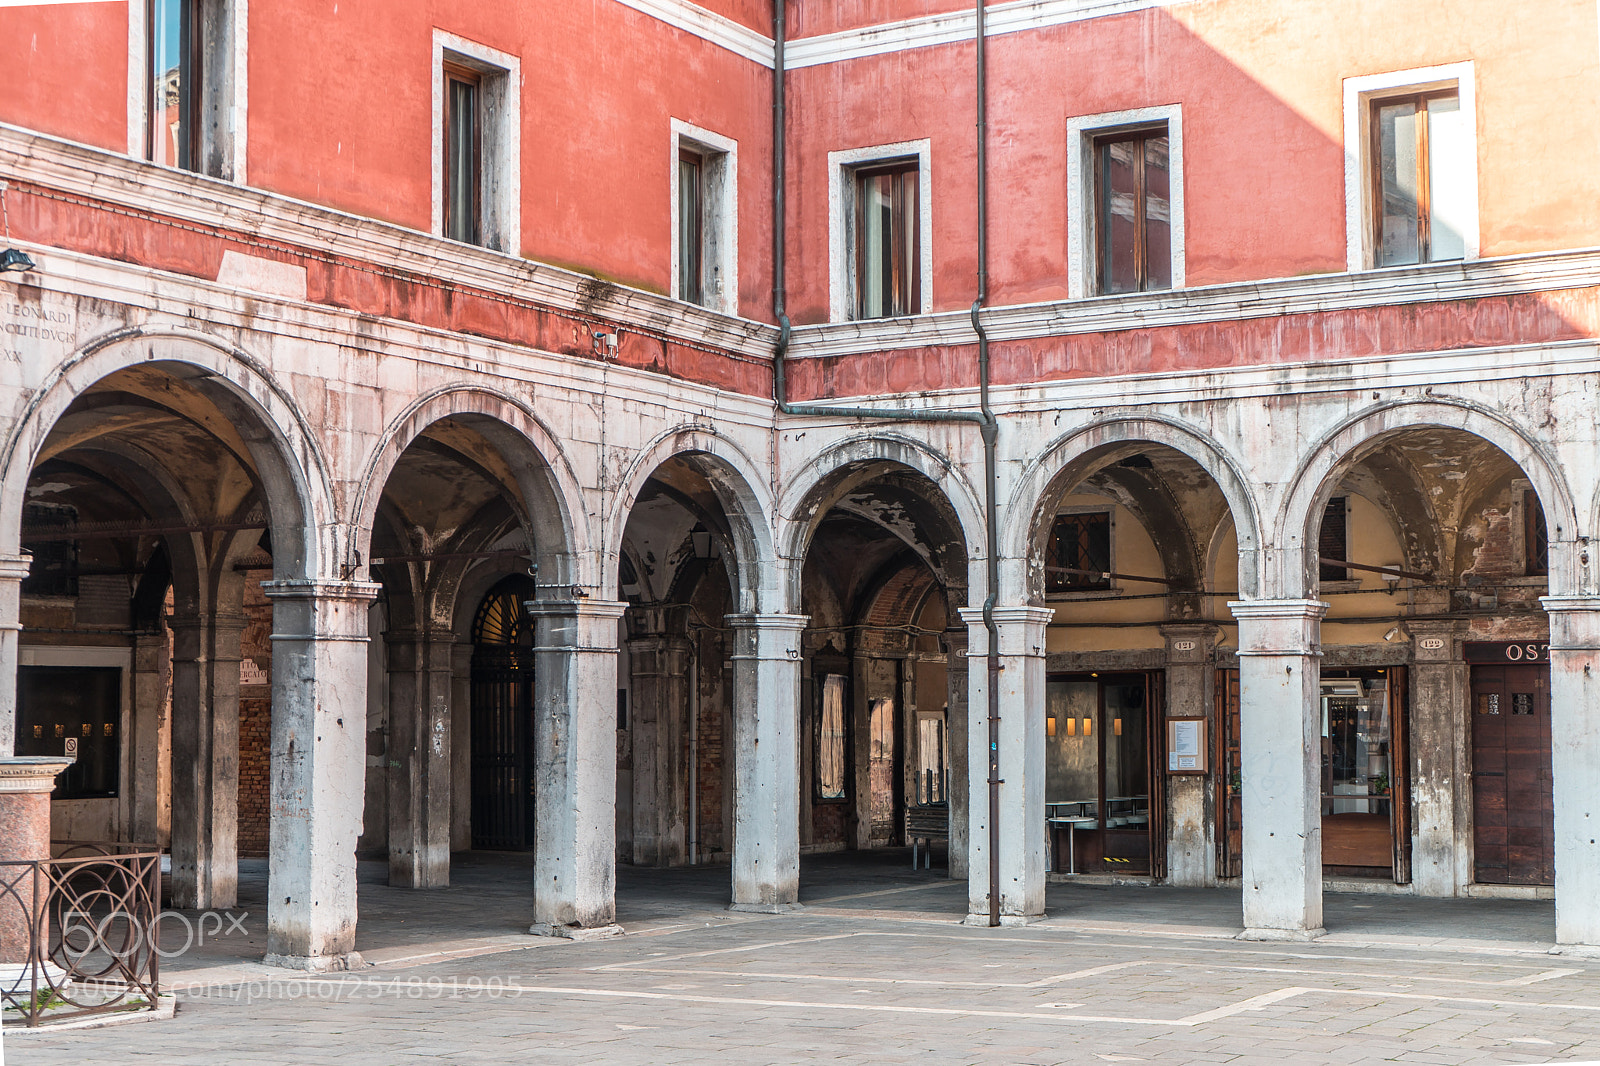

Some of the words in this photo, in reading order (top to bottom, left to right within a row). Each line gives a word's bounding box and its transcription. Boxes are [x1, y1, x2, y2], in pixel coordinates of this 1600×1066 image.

[7, 303, 71, 324] LEONARDI
[1424, 640, 1440, 648] 122
[1505, 644, 1551, 661] OST
